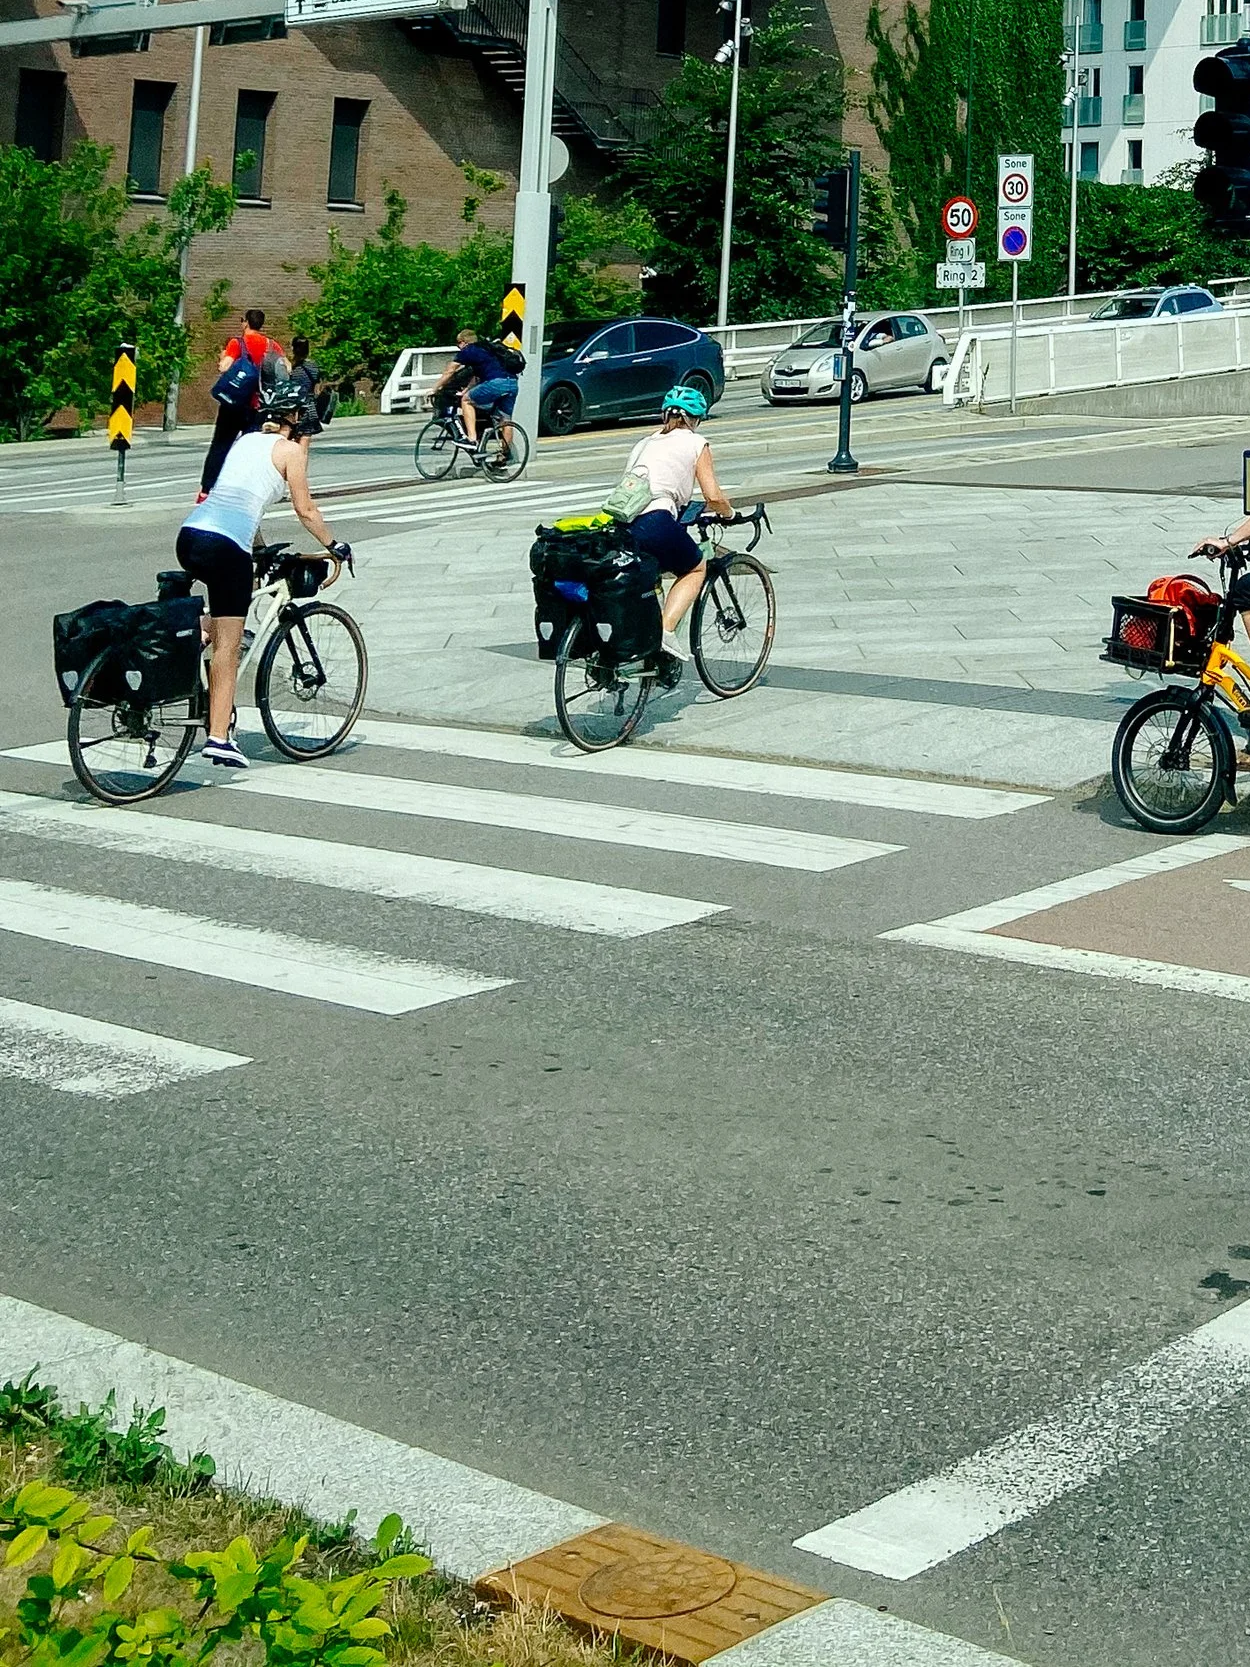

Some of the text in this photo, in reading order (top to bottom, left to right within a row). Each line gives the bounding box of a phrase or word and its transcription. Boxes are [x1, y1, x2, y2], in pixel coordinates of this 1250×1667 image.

[1004, 158, 1027, 169] Sone
[1007, 180, 1024, 196] 30
[949, 208, 972, 228] 50
[1003, 211, 1026, 221] Sone
[950, 246, 964, 260] Ring
[943, 269, 978, 283] Ring 2
